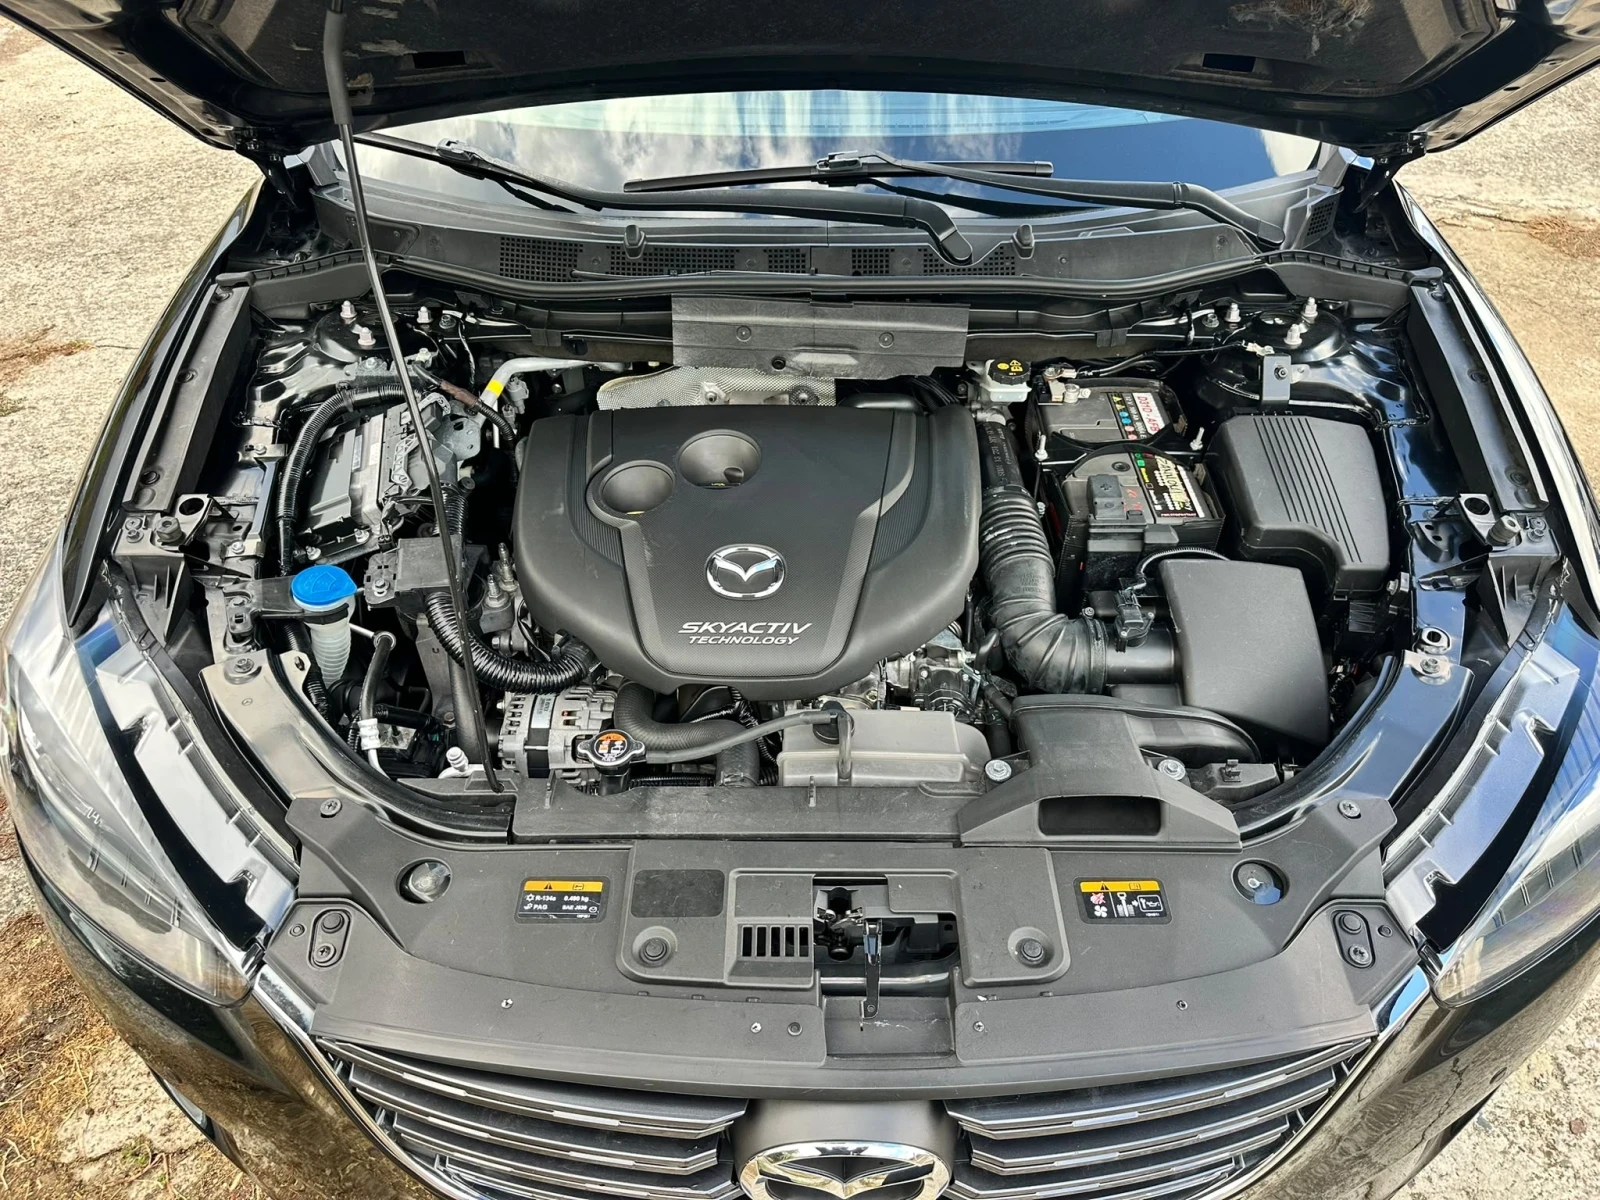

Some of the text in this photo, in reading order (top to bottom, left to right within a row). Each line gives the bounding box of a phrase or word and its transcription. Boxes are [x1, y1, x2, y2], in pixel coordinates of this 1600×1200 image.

[677, 621, 813, 634] SKYACTIV
[688, 635, 800, 645] TECHNOLOGY
[580, 895, 590, 903] kg
